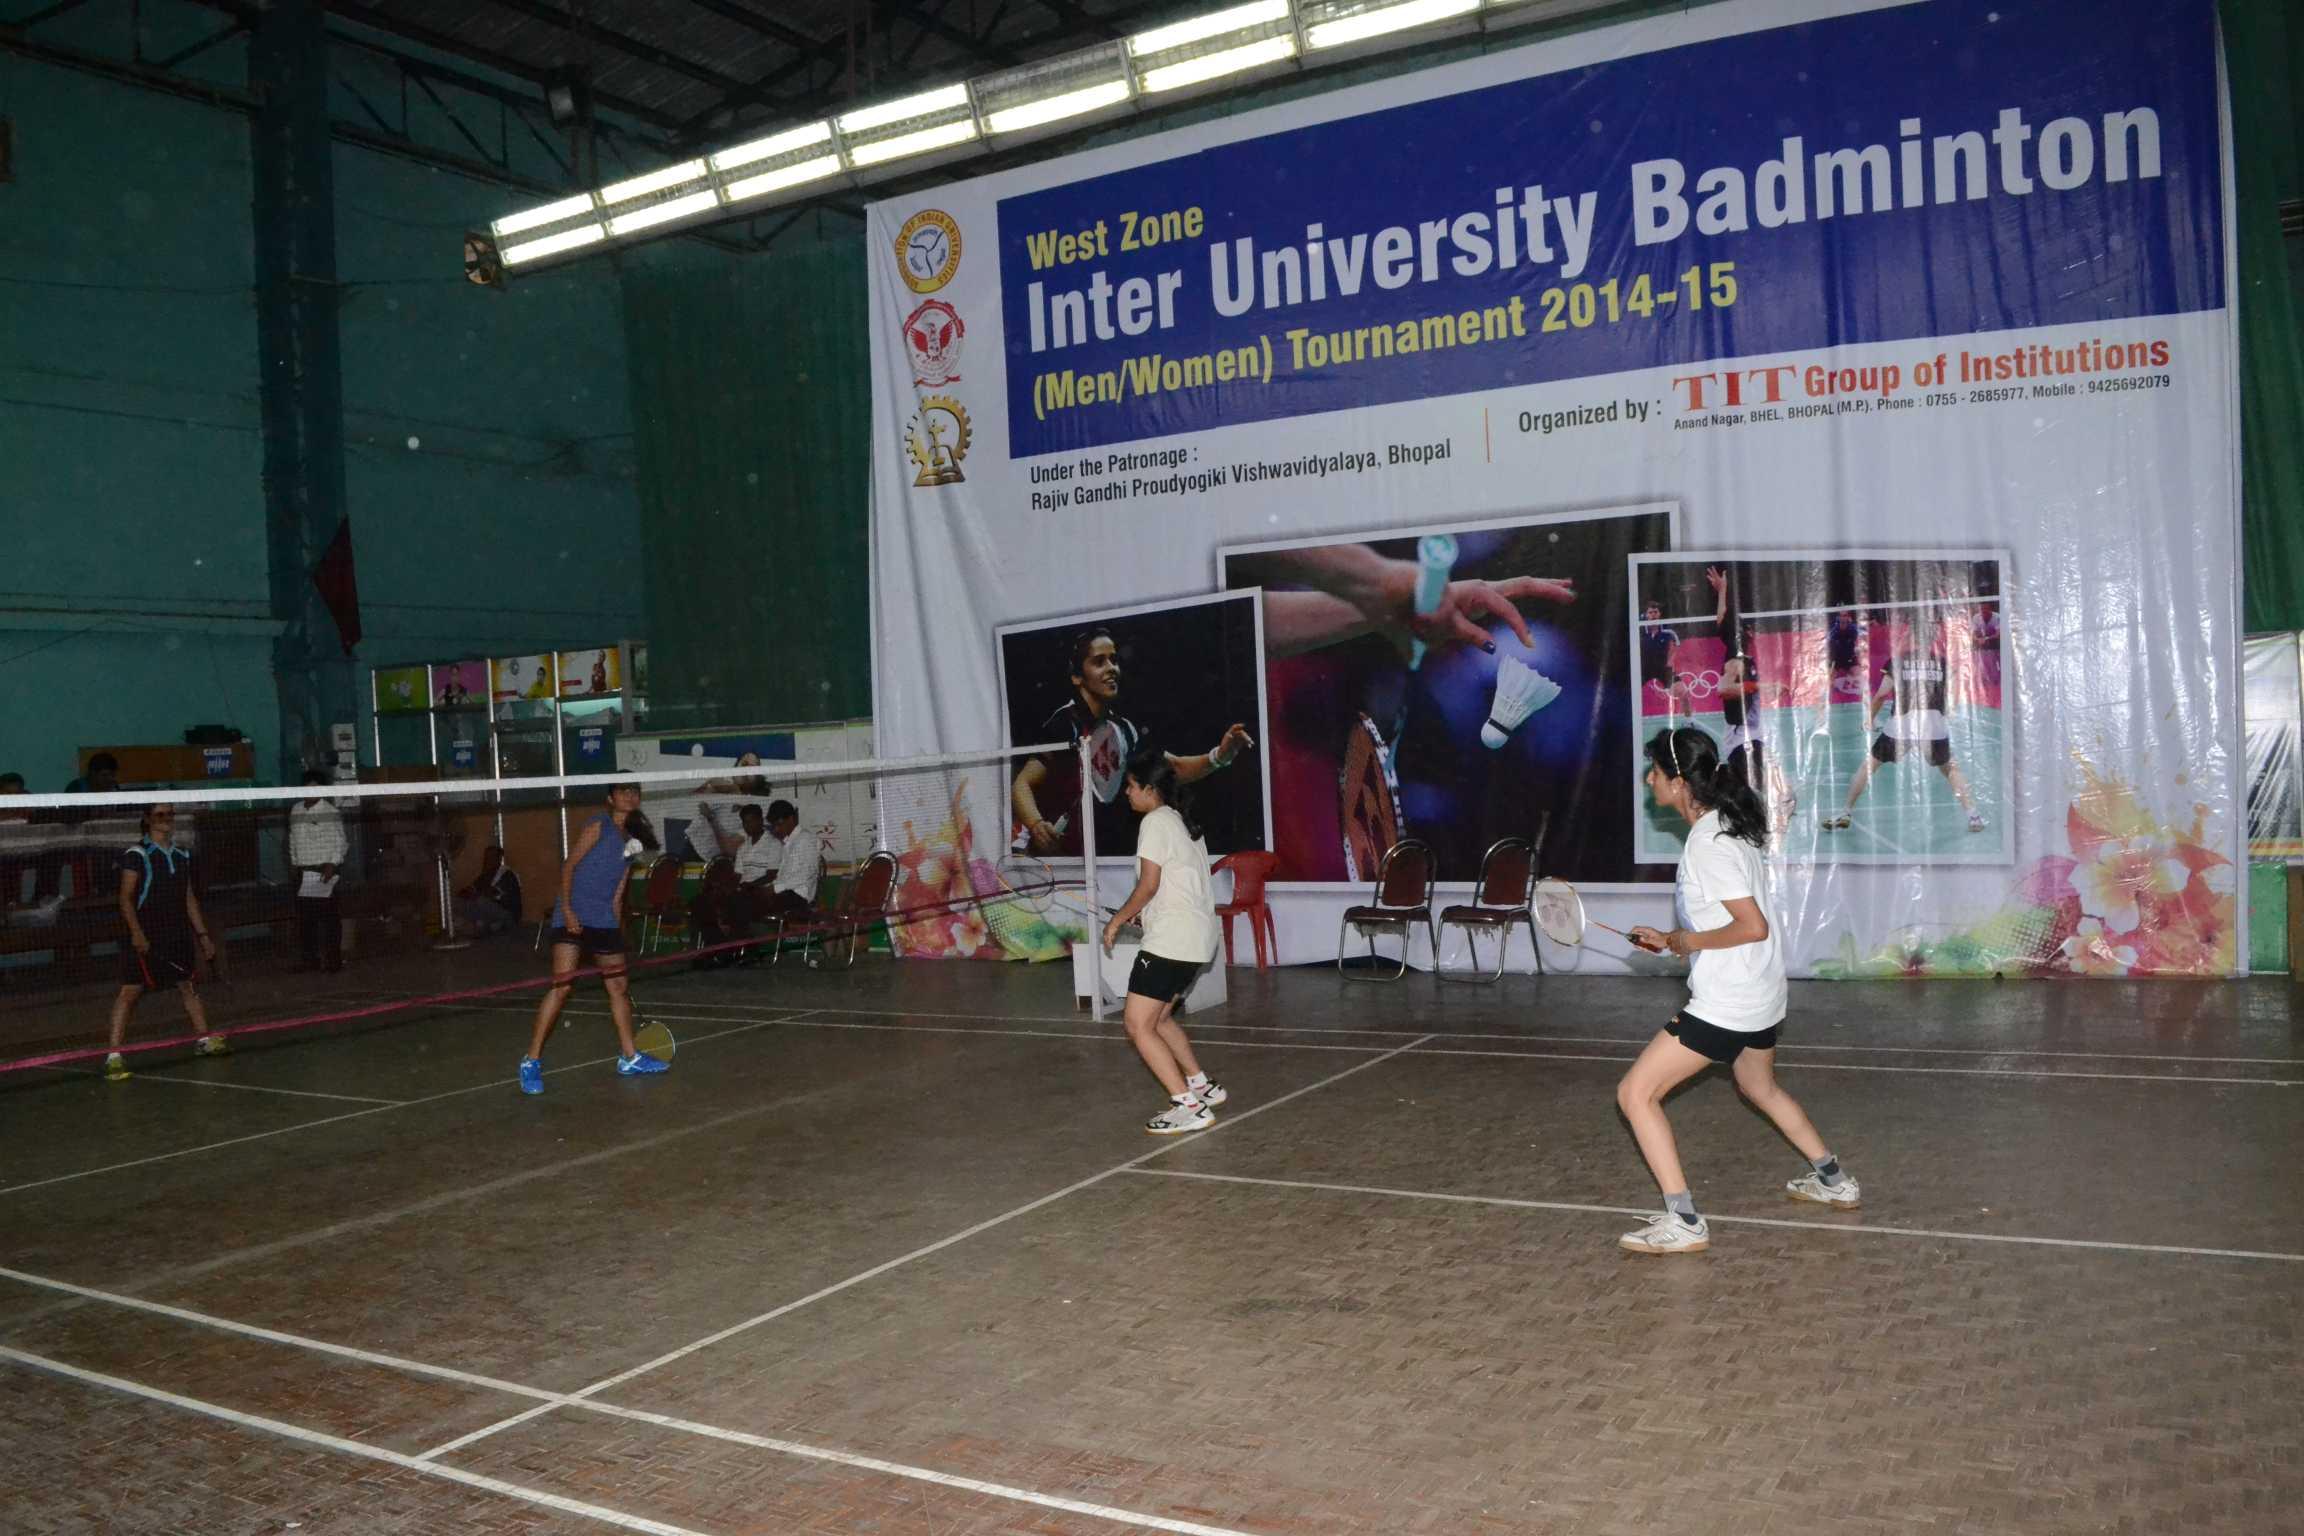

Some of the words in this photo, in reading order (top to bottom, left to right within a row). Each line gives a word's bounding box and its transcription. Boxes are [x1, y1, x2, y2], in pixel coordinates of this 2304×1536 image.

[1026, 219, 1109, 270] West
[1120, 206, 1204, 251] Zone
[1028, 267, 1184, 353] Inter
[1210, 185, 1597, 317] University
[1631, 105, 2163, 246] Badminton
[1032, 334, 1273, 421] (Men/Women)
[1287, 296, 1526, 370] Tournament
[1541, 261, 1738, 334] 2014-15
[1672, 365, 1797, 412] TIT
[1804, 363, 1900, 398] Group
[1913, 353, 1947, 388] of
[1960, 338, 2171, 383] Institutions
[1518, 400, 1618, 434] Organized
[1625, 398, 1650, 423] by
[1674, 411, 1708, 431] Anand
[1711, 411, 1747, 428] Nagar,
[1788, 403, 1834, 420] BHOPAL
[1877, 396, 1914, 411] Phone
[1926, 389, 1957, 407] 0755
[2032, 381, 2076, 399] Mobile
[2088, 374, 2171, 395] 9425692079
[1030, 463, 1075, 484] Under
[1079, 458, 1103, 477] the
[1108, 448, 1188, 473] Patronage
[1032, 489, 1069, 512] Rajiv
[1074, 480, 1128, 505] Gandhi
[1132, 465, 1227, 498] Proudyogiki
[1232, 451, 1382, 484] Vishwavidyalaya,
[1388, 437, 1451, 466] Bhopal
